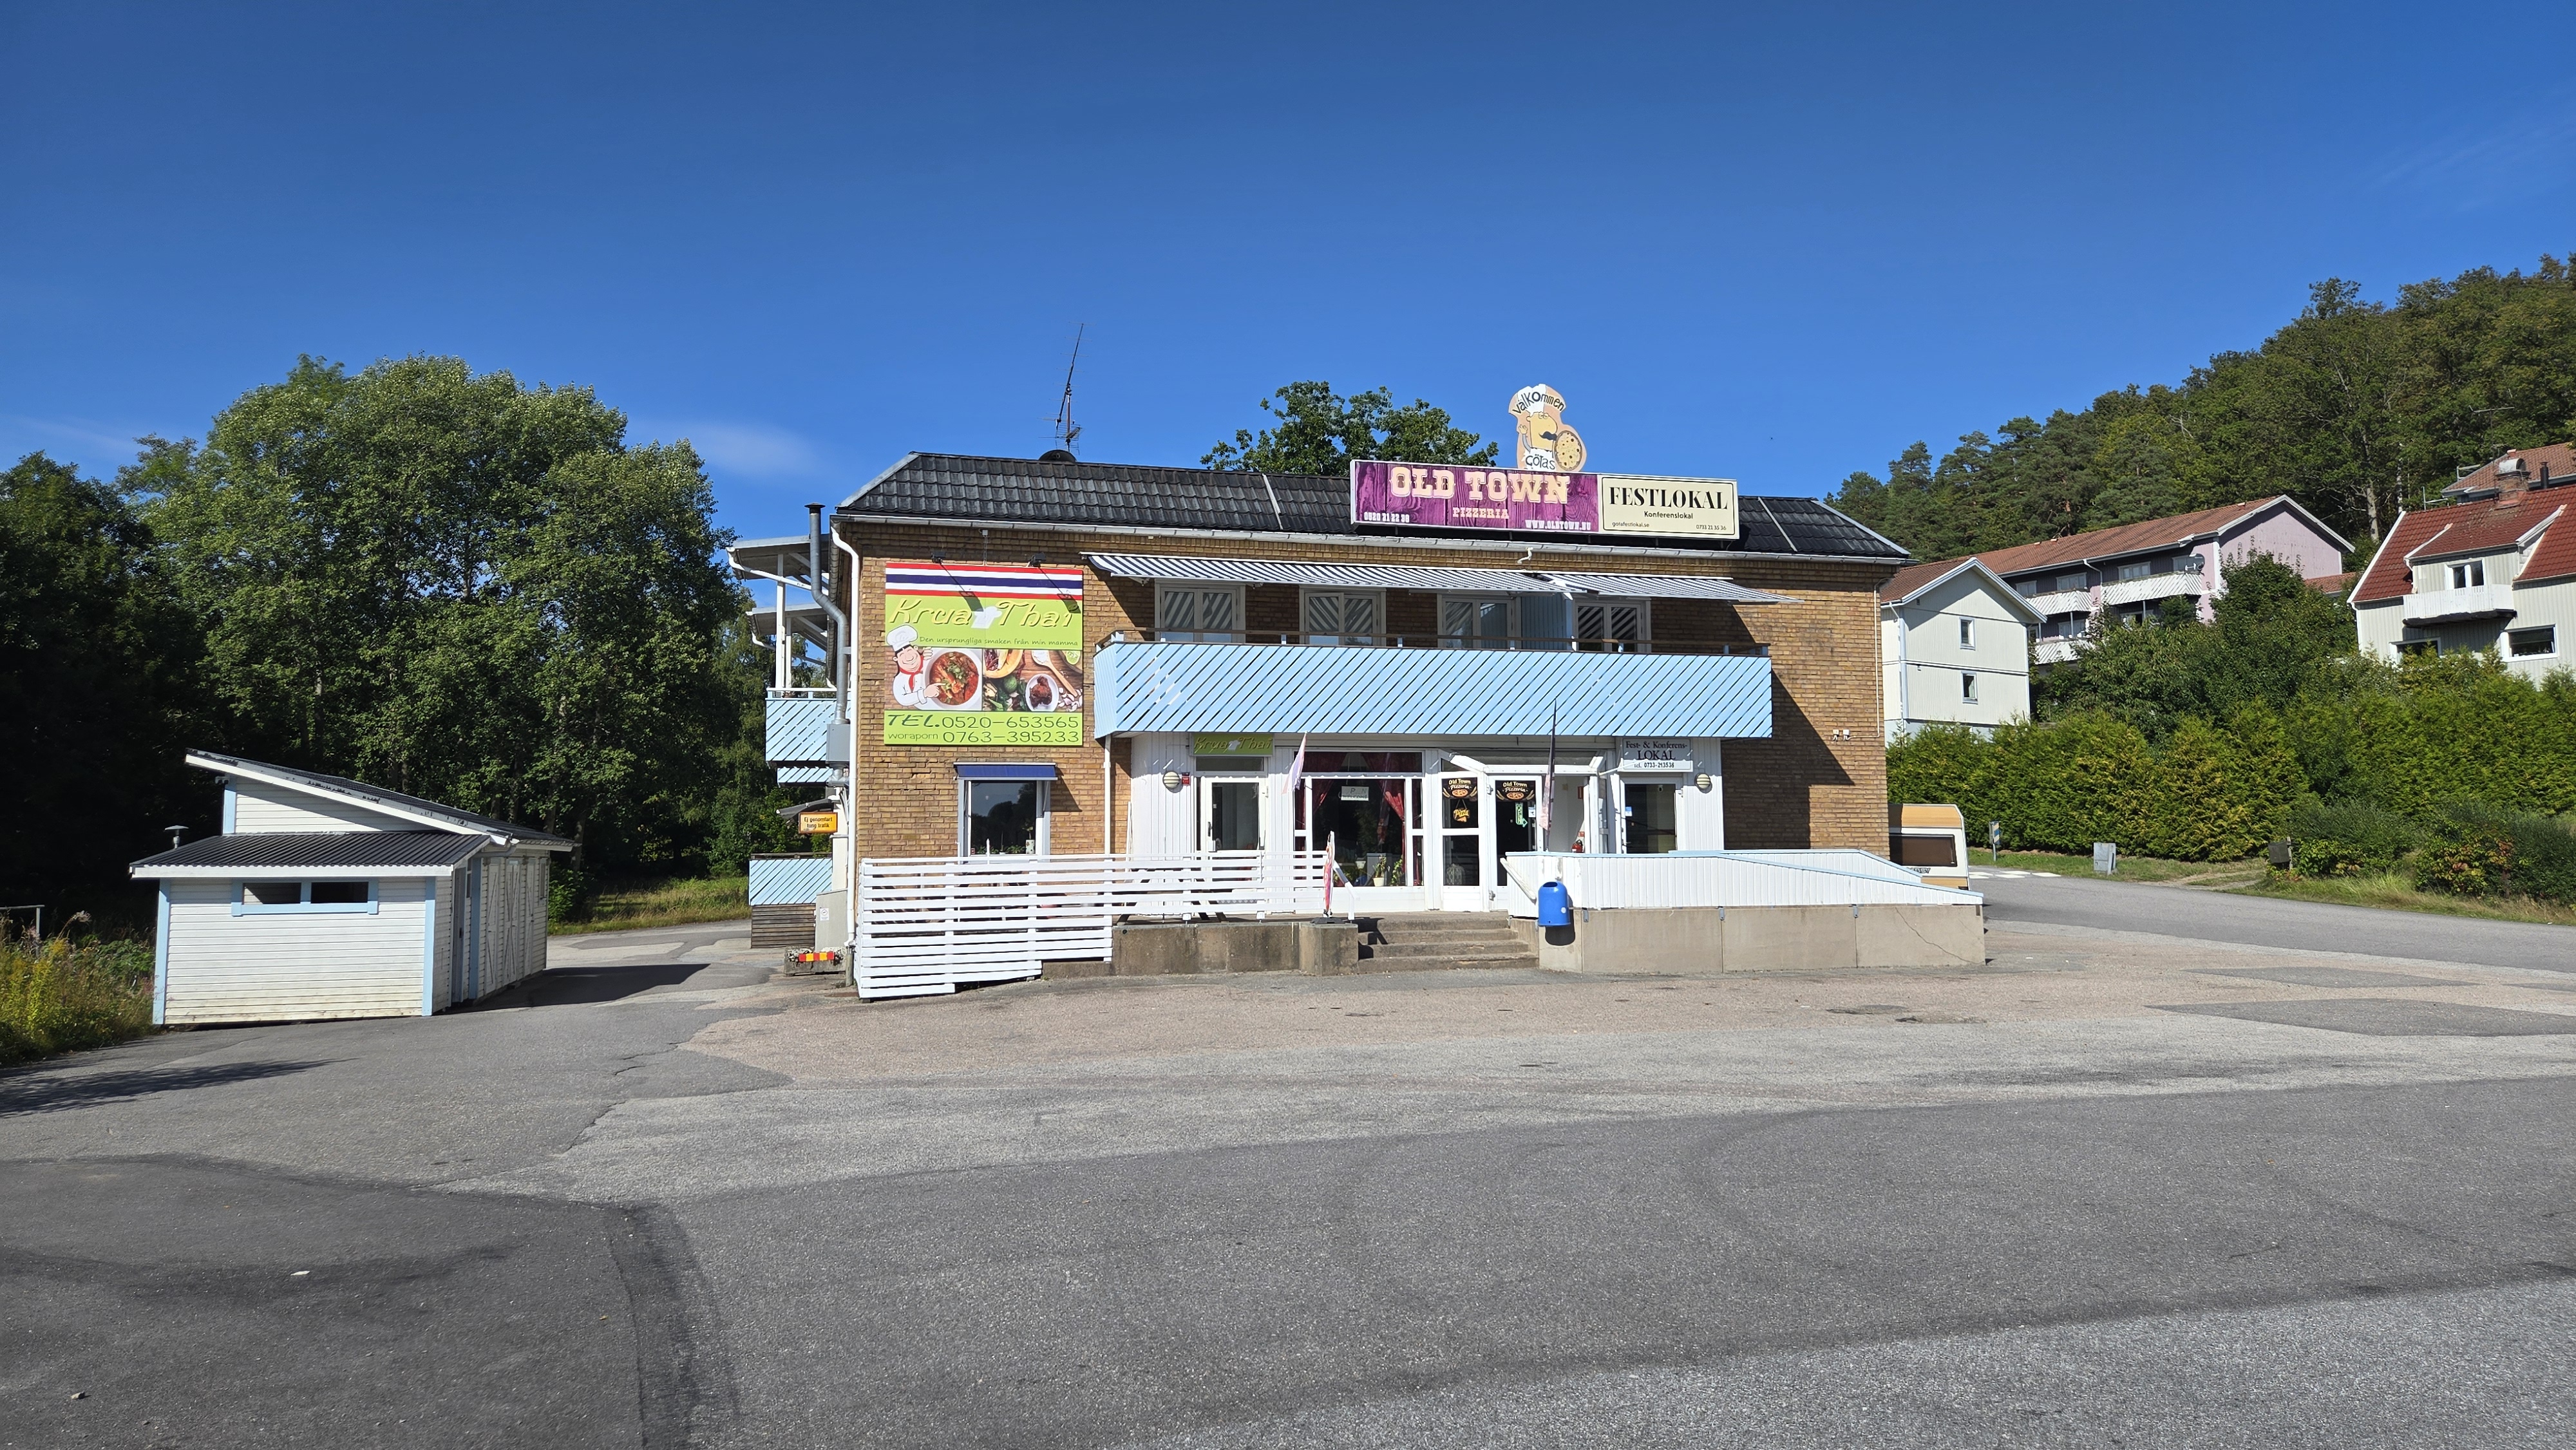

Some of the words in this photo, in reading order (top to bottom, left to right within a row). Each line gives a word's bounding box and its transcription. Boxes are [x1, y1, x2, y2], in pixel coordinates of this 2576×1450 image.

[1512, 391, 1565, 413] Välkommen
[1389, 466, 1455, 499] OLD
[1464, 471, 1570, 504] TOWN
[1609, 487, 1728, 509] FESTLOKAL
[1363, 512, 1381, 521] 0520
[1382, 513, 1390, 522] 21
[1391, 513, 1400, 522] 22
[1452, 507, 1510, 519] PIZZERIA
[1643, 511, 1694, 519] Konferenslokal
[889, 598, 972, 625] Krua
[996, 599, 1079, 628] Thai
[936, 637, 983, 645] ursprungliga
[887, 714, 940, 728] TEL.
[942, 716, 1079, 728] 0520-653565
[887, 732, 939, 740] woraporn
[943, 731, 1079, 742] 0763-395233
[1237, 736, 1273, 749] Thai
[1653, 740, 1687, 749] Konferens-
[1637, 750, 1676, 760] LOKAL
[1453, 809, 1469, 819] Pizza
